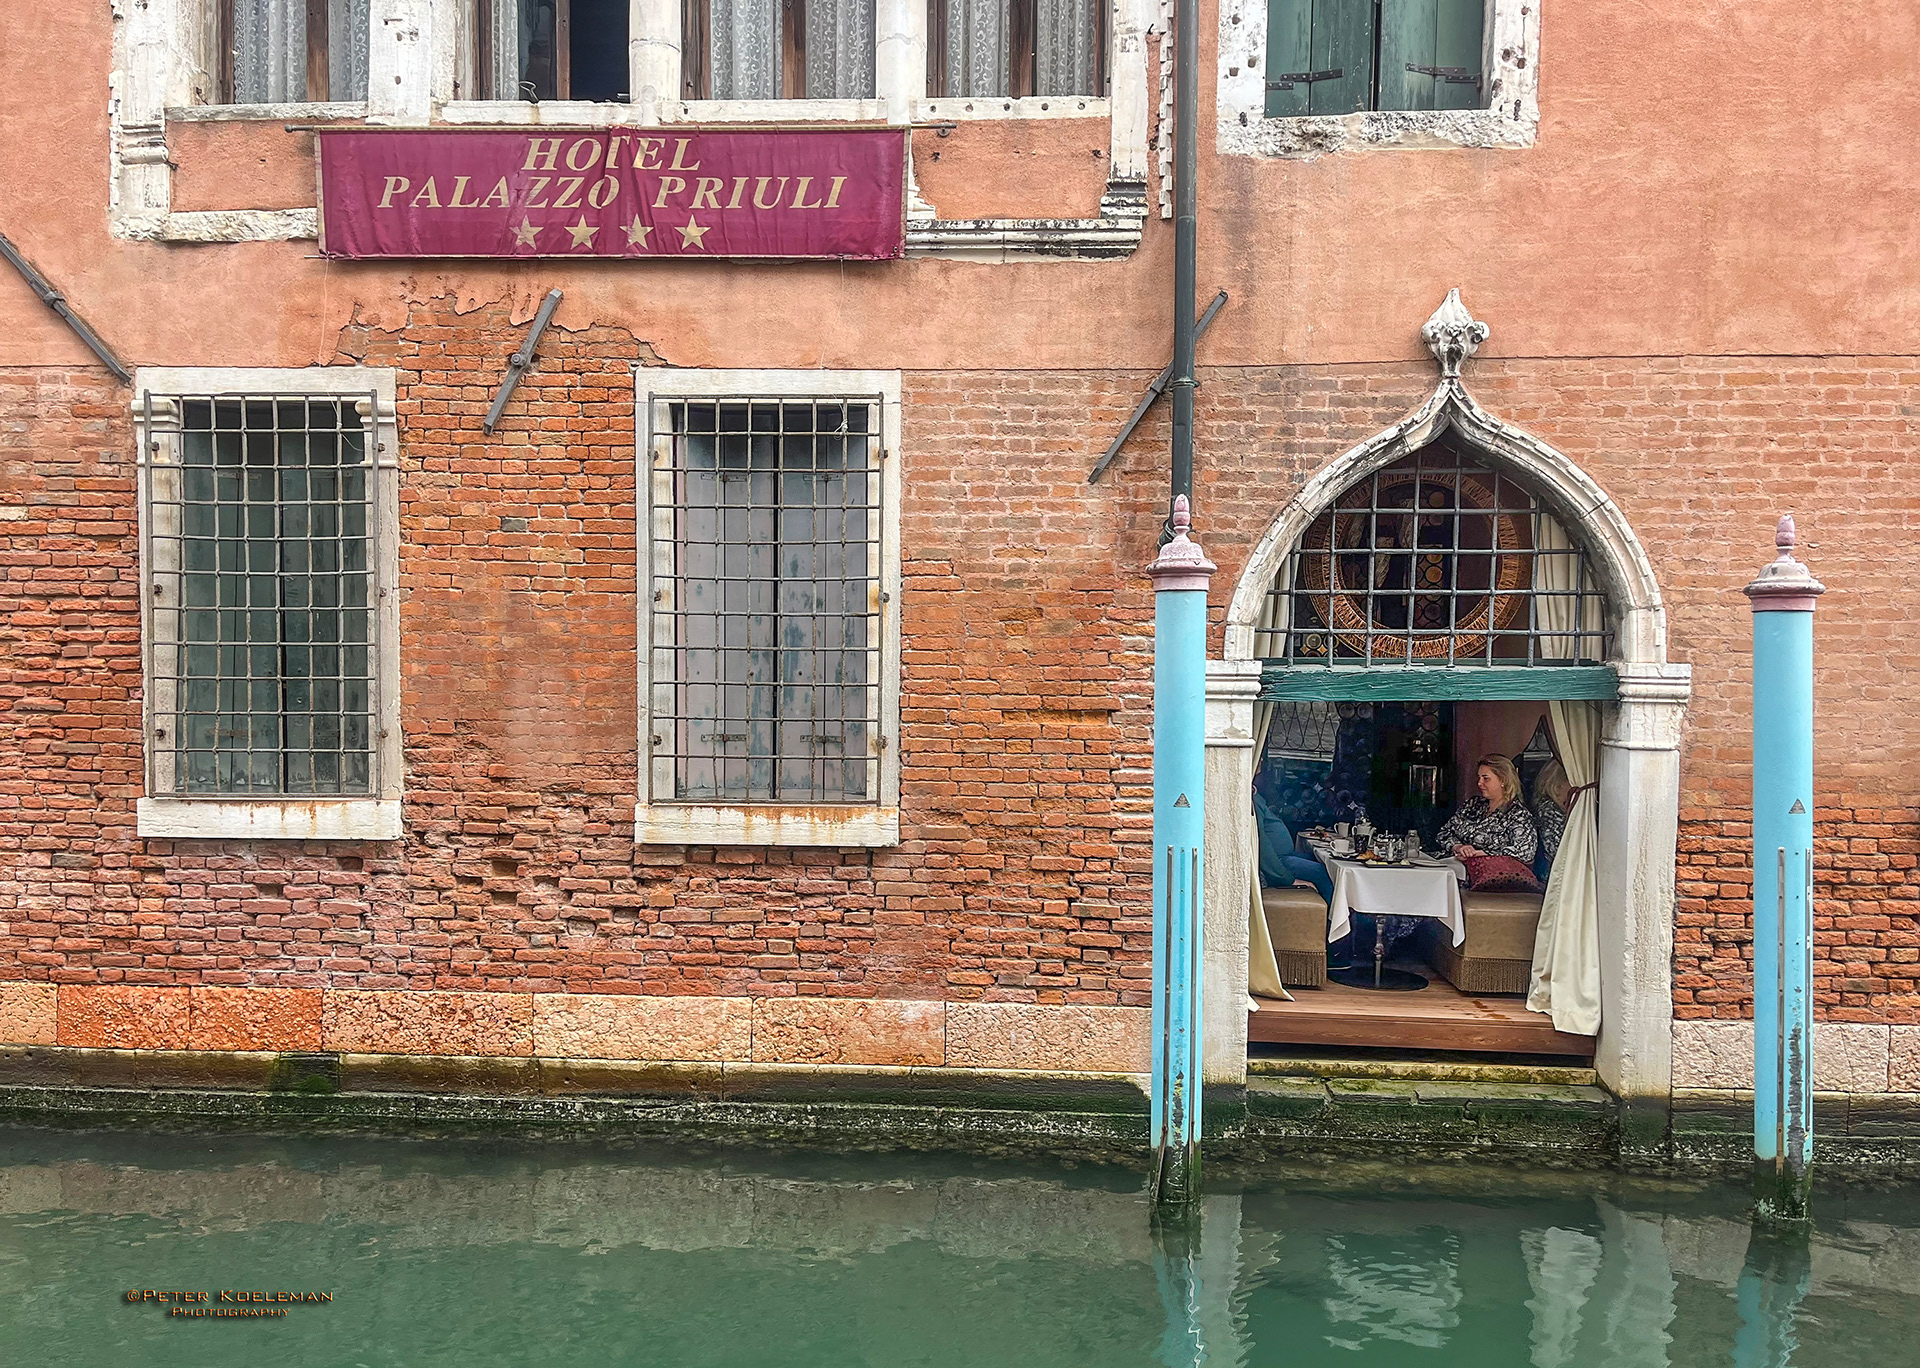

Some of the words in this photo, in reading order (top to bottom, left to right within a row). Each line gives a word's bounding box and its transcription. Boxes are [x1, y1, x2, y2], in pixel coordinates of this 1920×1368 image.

[521, 135, 700, 171] HOTEL
[377, 174, 620, 209] PALAZZO
[652, 176, 847, 209] PRIULI
